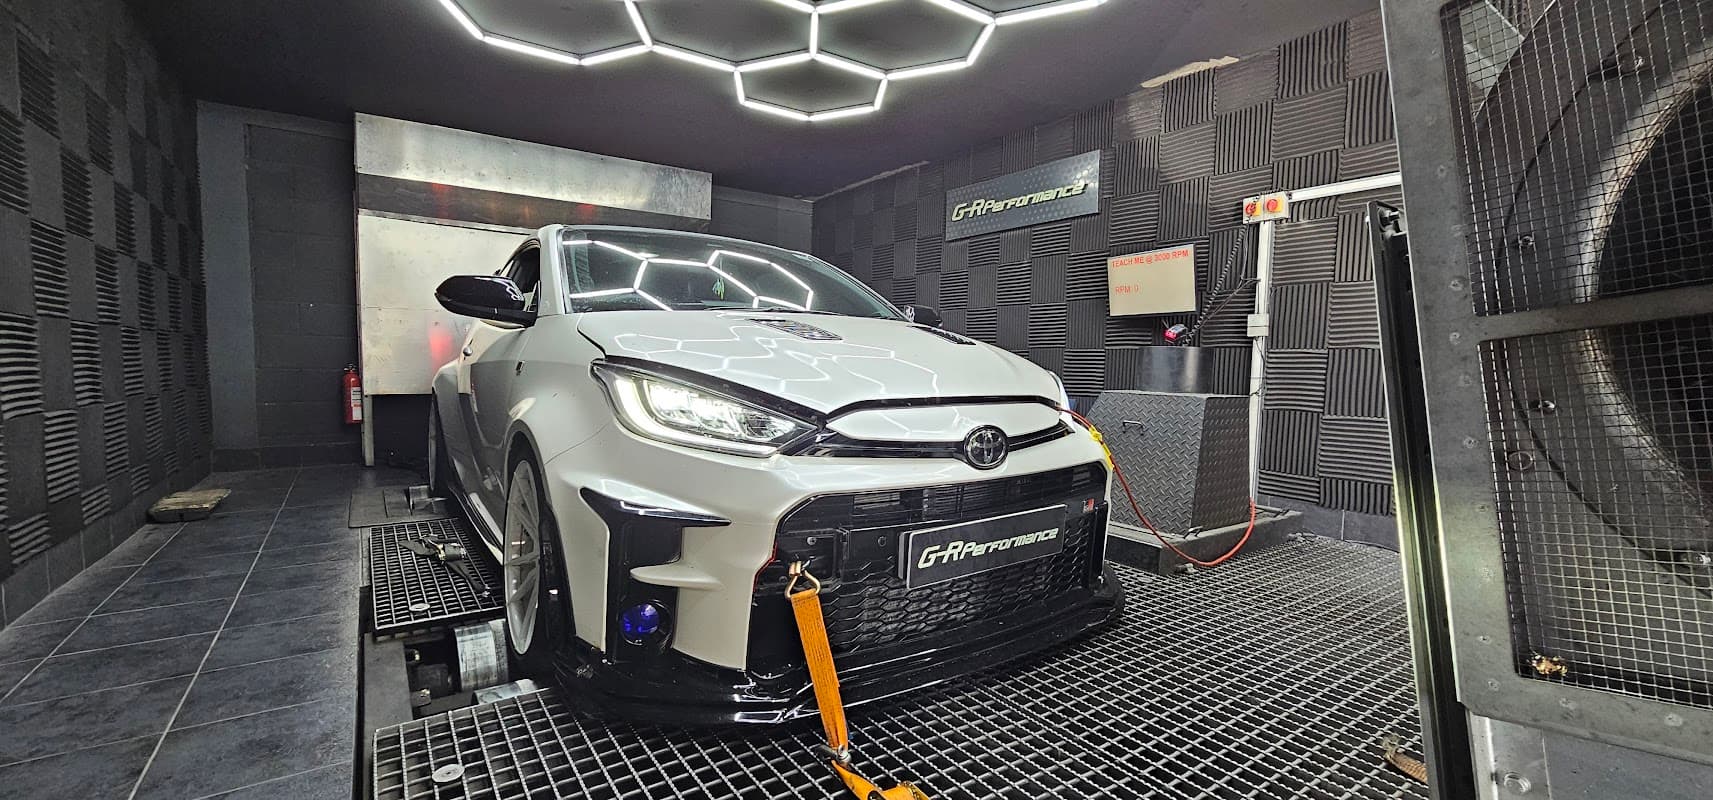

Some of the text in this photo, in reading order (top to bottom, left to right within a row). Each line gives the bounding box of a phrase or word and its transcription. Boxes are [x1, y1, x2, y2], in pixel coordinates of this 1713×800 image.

[1112, 258, 1132, 268] TEACH
[1134, 256, 1144, 264] ME
[1146, 256, 1153, 264] @
[1172, 249, 1189, 258] RPM
